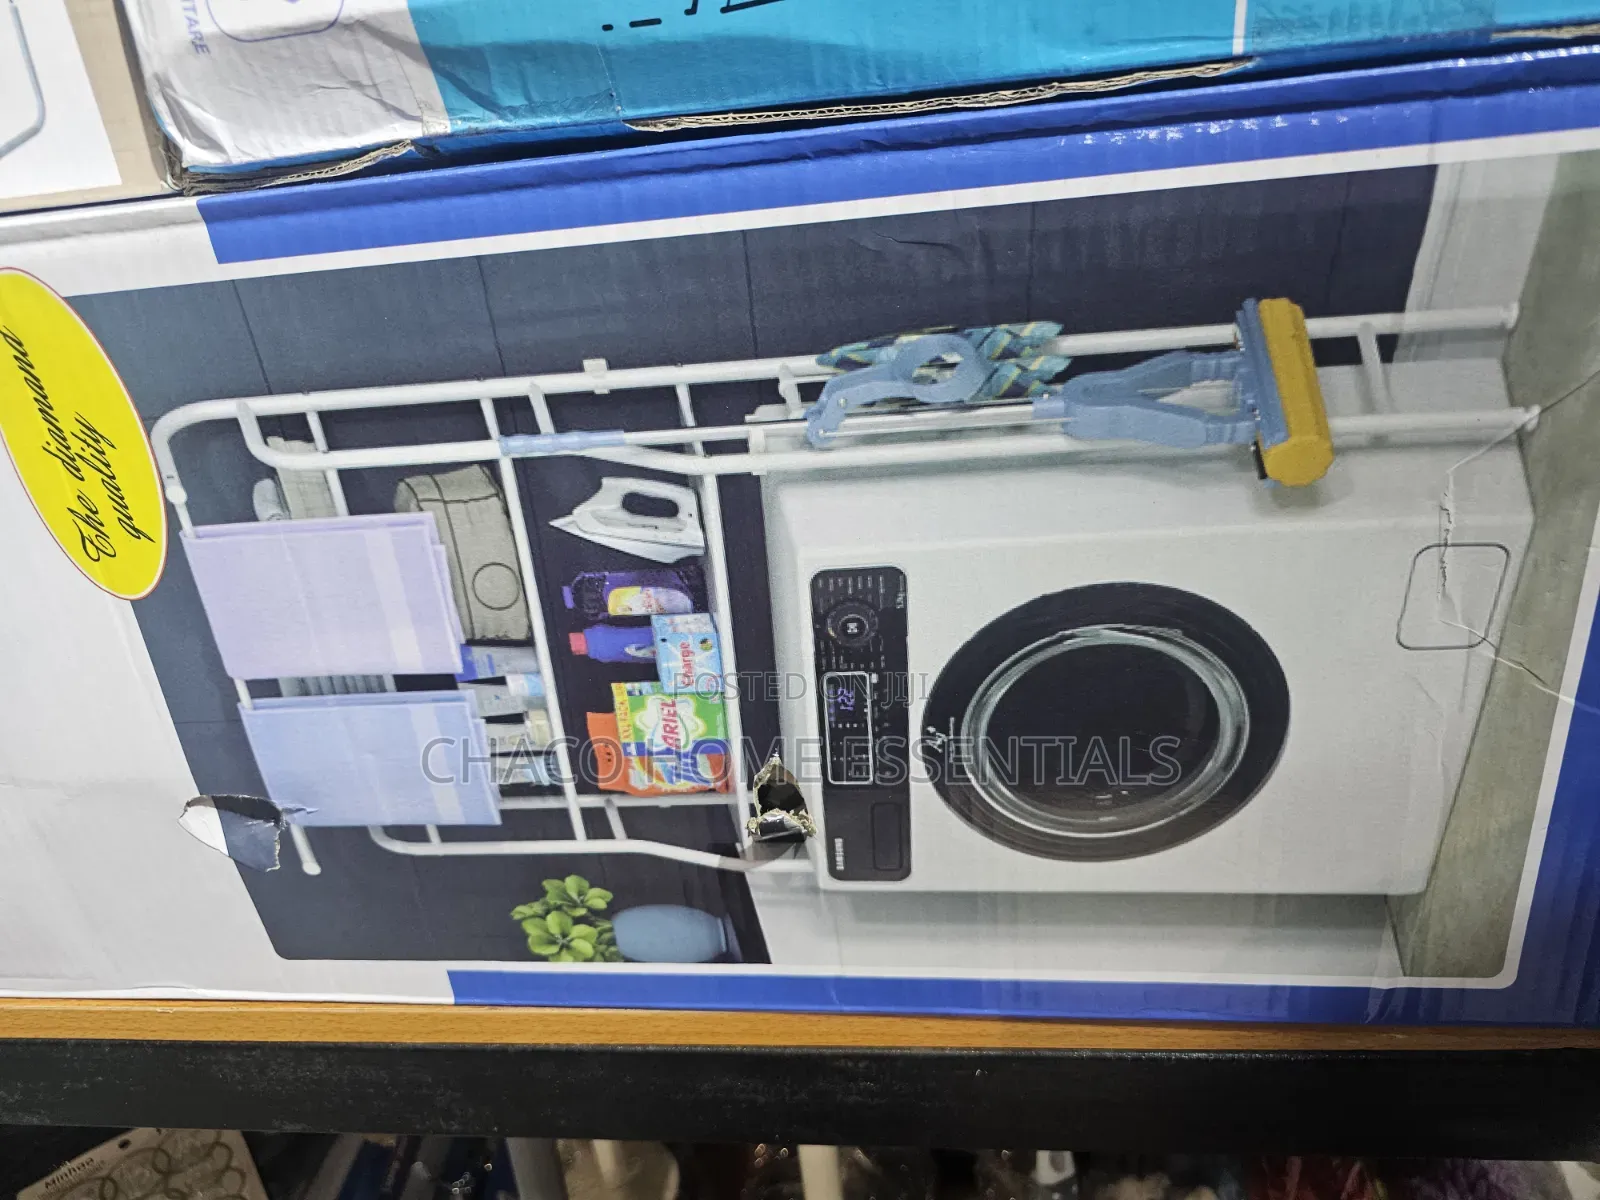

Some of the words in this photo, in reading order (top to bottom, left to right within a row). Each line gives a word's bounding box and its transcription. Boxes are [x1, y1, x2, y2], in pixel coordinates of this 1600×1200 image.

[70, 411, 156, 543] quality
[67, 488, 116, 562] The
[660, 698, 681, 750] ARIEL
